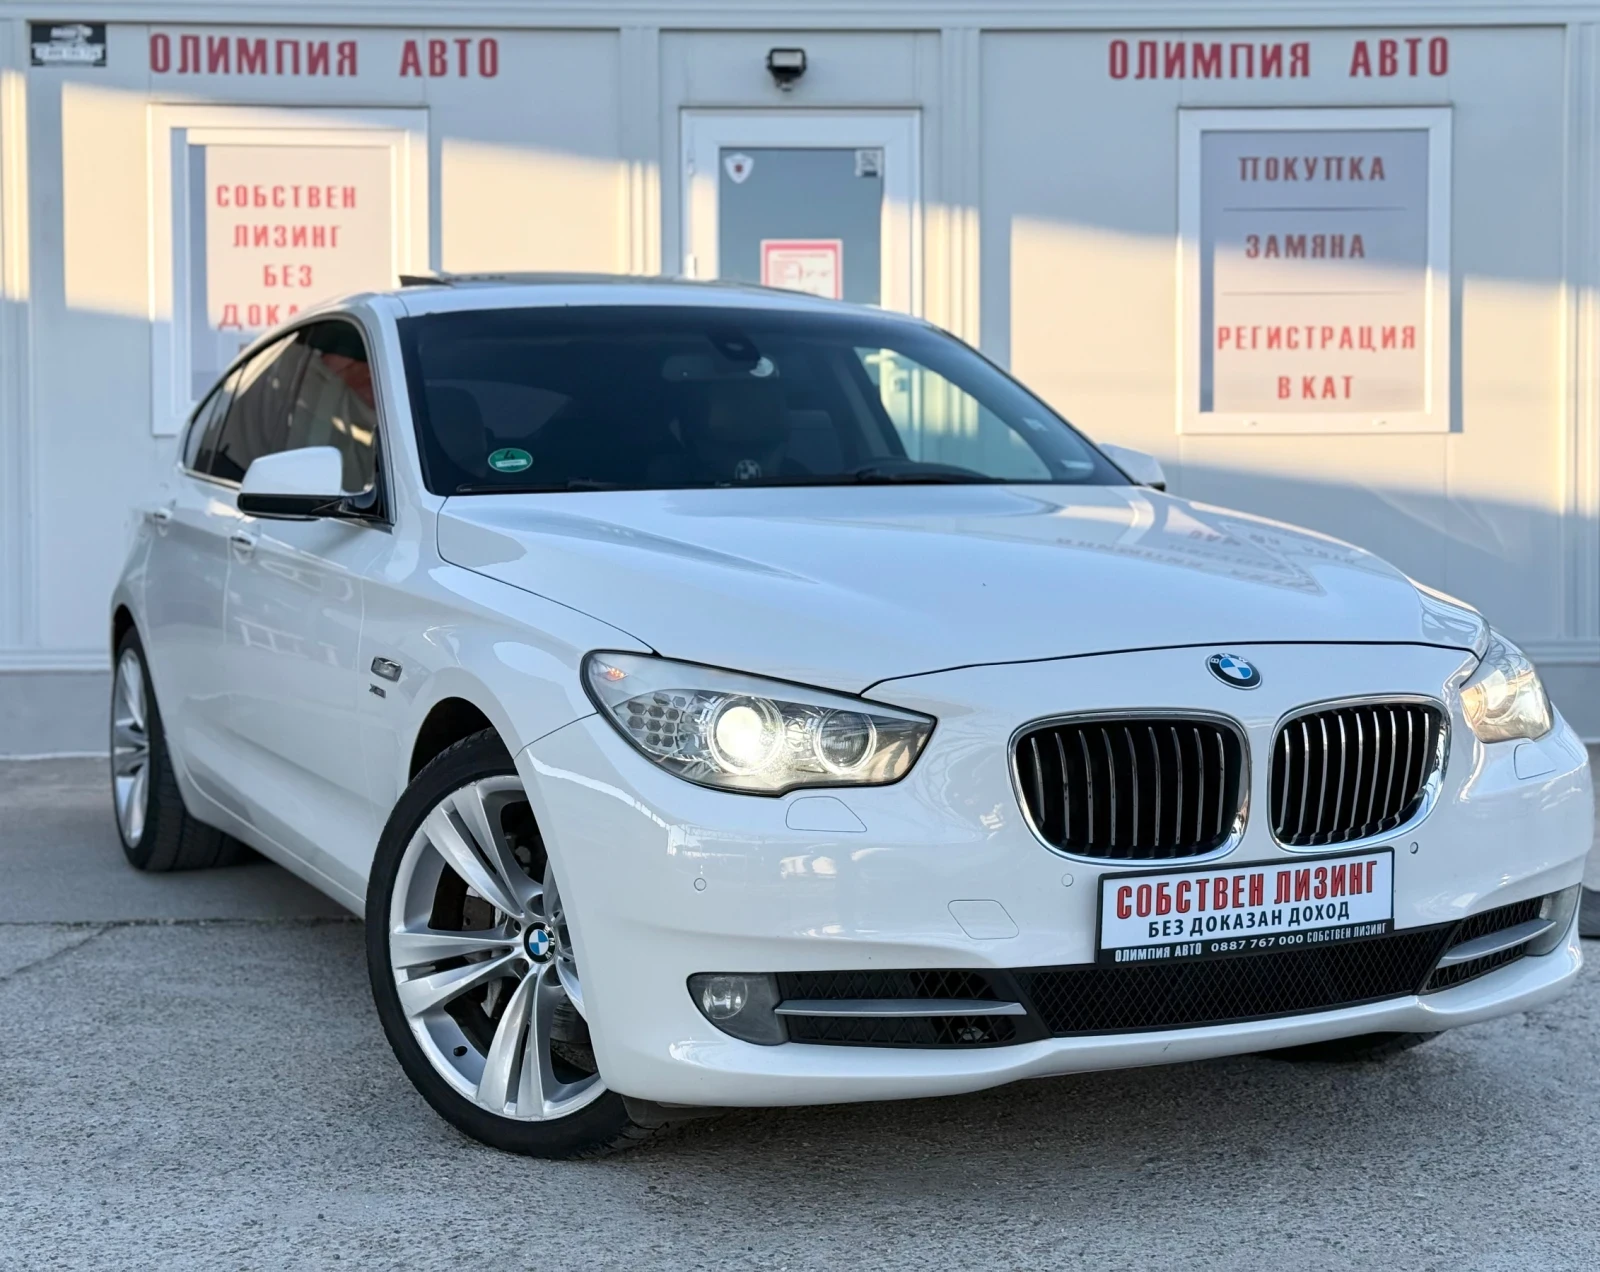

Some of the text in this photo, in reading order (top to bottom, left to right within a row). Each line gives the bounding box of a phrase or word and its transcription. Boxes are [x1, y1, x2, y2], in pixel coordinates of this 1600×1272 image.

[150, 33, 499, 78] ОЛИМПИЯ АВТО
[1109, 36, 1449, 79] ОЛИМПИЯ АВТО
[1239, 156, 1386, 182] ПОКУПКА
[215, 184, 357, 209] СОБСТВЕН
[233, 224, 341, 249] ЛИЗИНГ
[1245, 234, 1365, 260] ЗАМЯНА
[262, 264, 313, 289] БЕЗ
[1217, 325, 1417, 352] РЕГИСТРАЦИЯ
[1301, 375, 1354, 400] КАТ
[1117, 860, 1378, 919] СОБСТВЕН ЛИЗИНГ
[1148, 900, 1350, 938] БЕЗ ДОКАЗАН ДОХОД
[1114, 922, 1387, 962] ОЛИМПИЯ АВТО 0887 767 000 СОБСТВЕН ЛИЗИНГ
